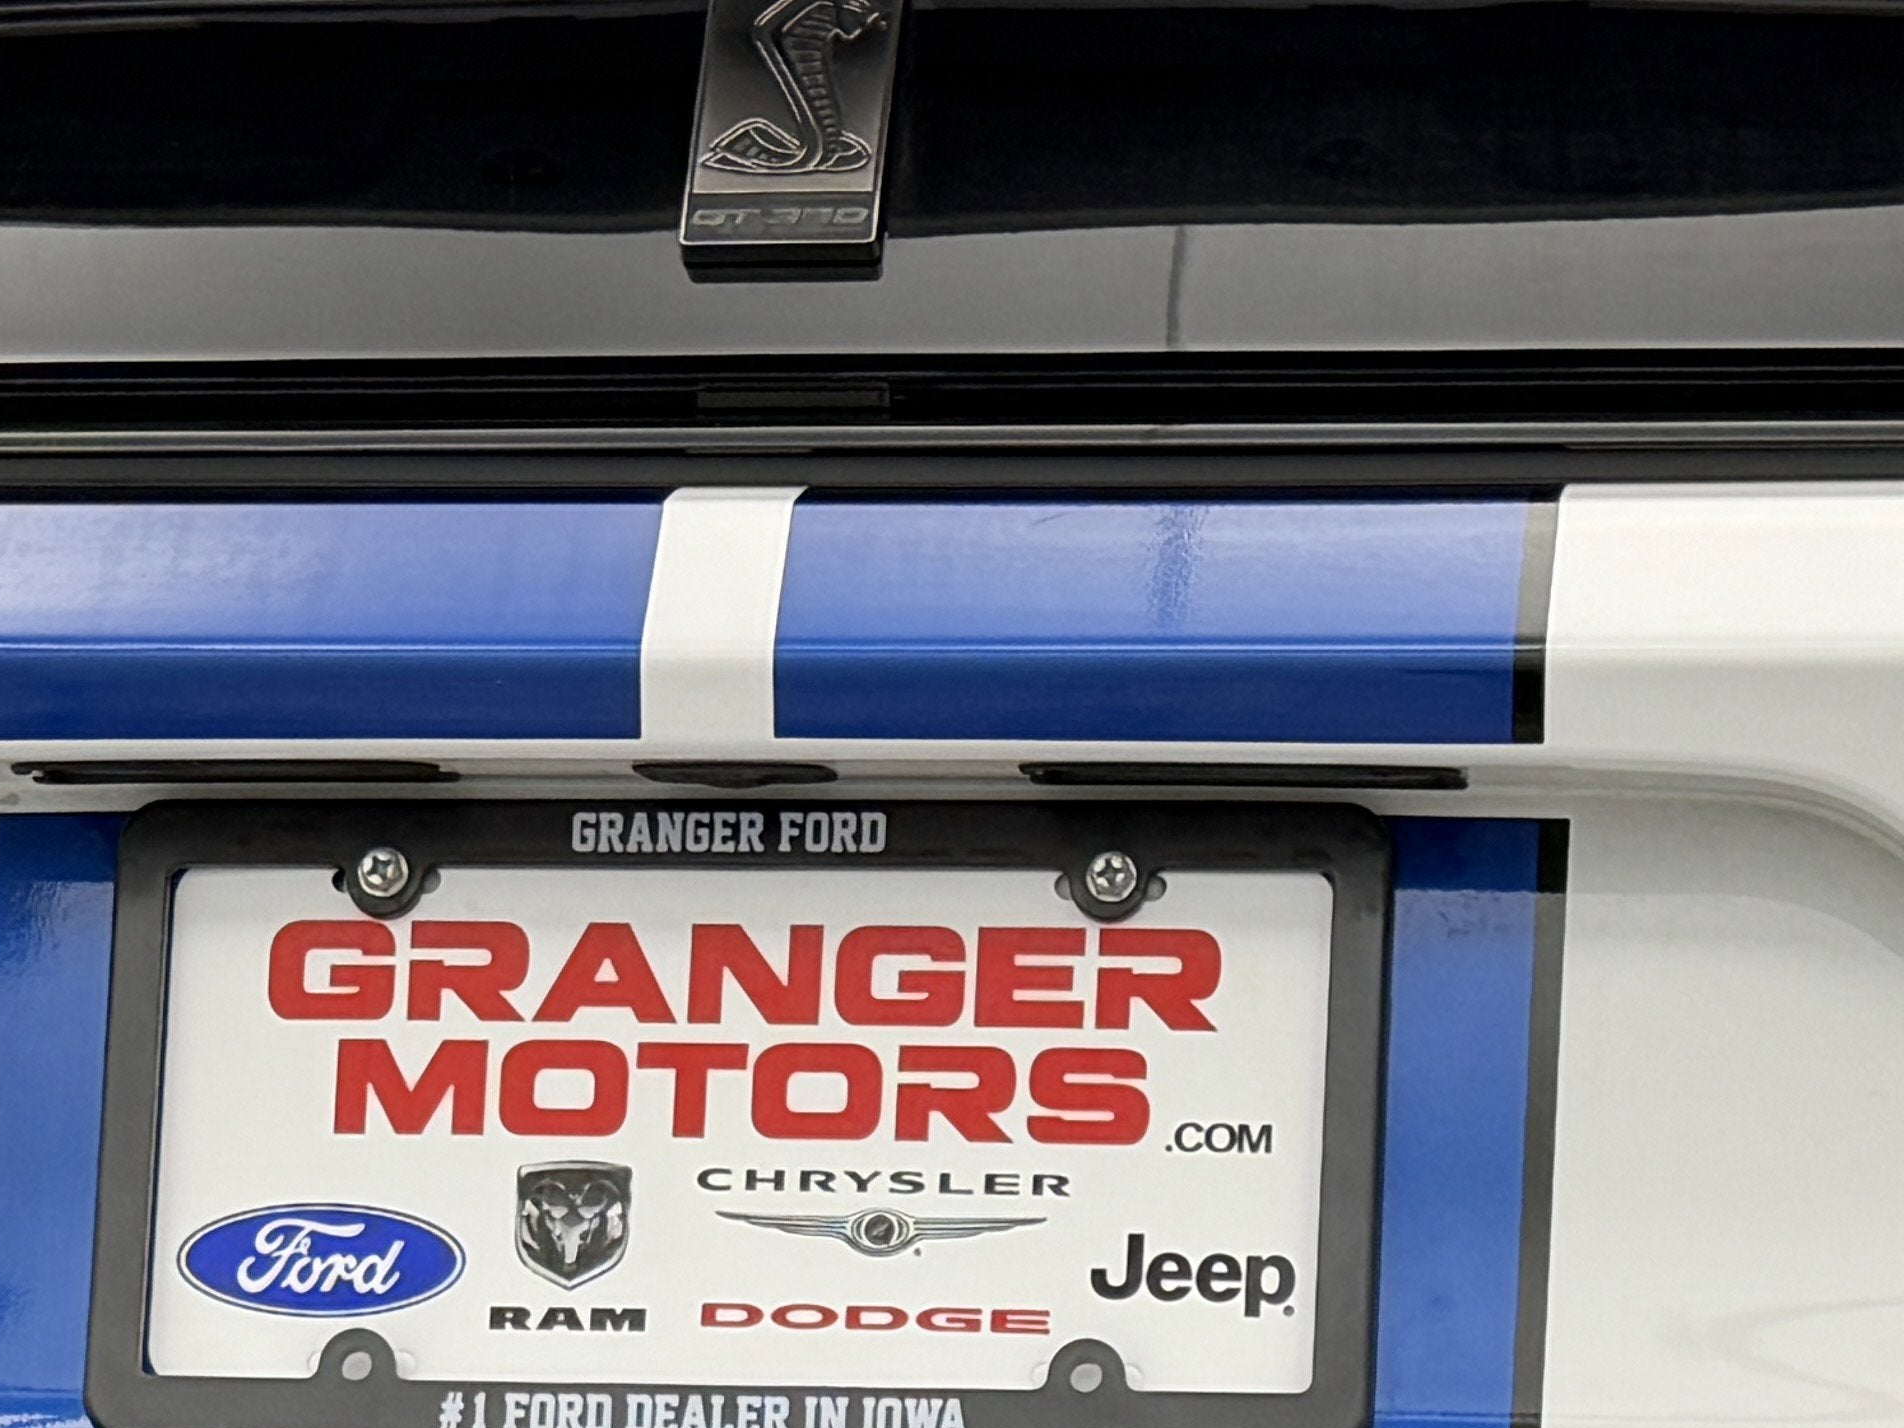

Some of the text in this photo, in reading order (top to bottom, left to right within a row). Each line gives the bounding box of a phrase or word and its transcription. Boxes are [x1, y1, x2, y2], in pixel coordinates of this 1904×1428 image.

[572, 812, 887, 853] GRANGER FORD
[267, 918, 1222, 1031] GRANGER
[333, 1038, 1151, 1146] MOTORS
[697, 1168, 1070, 1197] CHRYSLER
[236, 1217, 405, 1295] Ford
[489, 1306, 646, 1331] RAM
[701, 1303, 1049, 1334] DODGE
